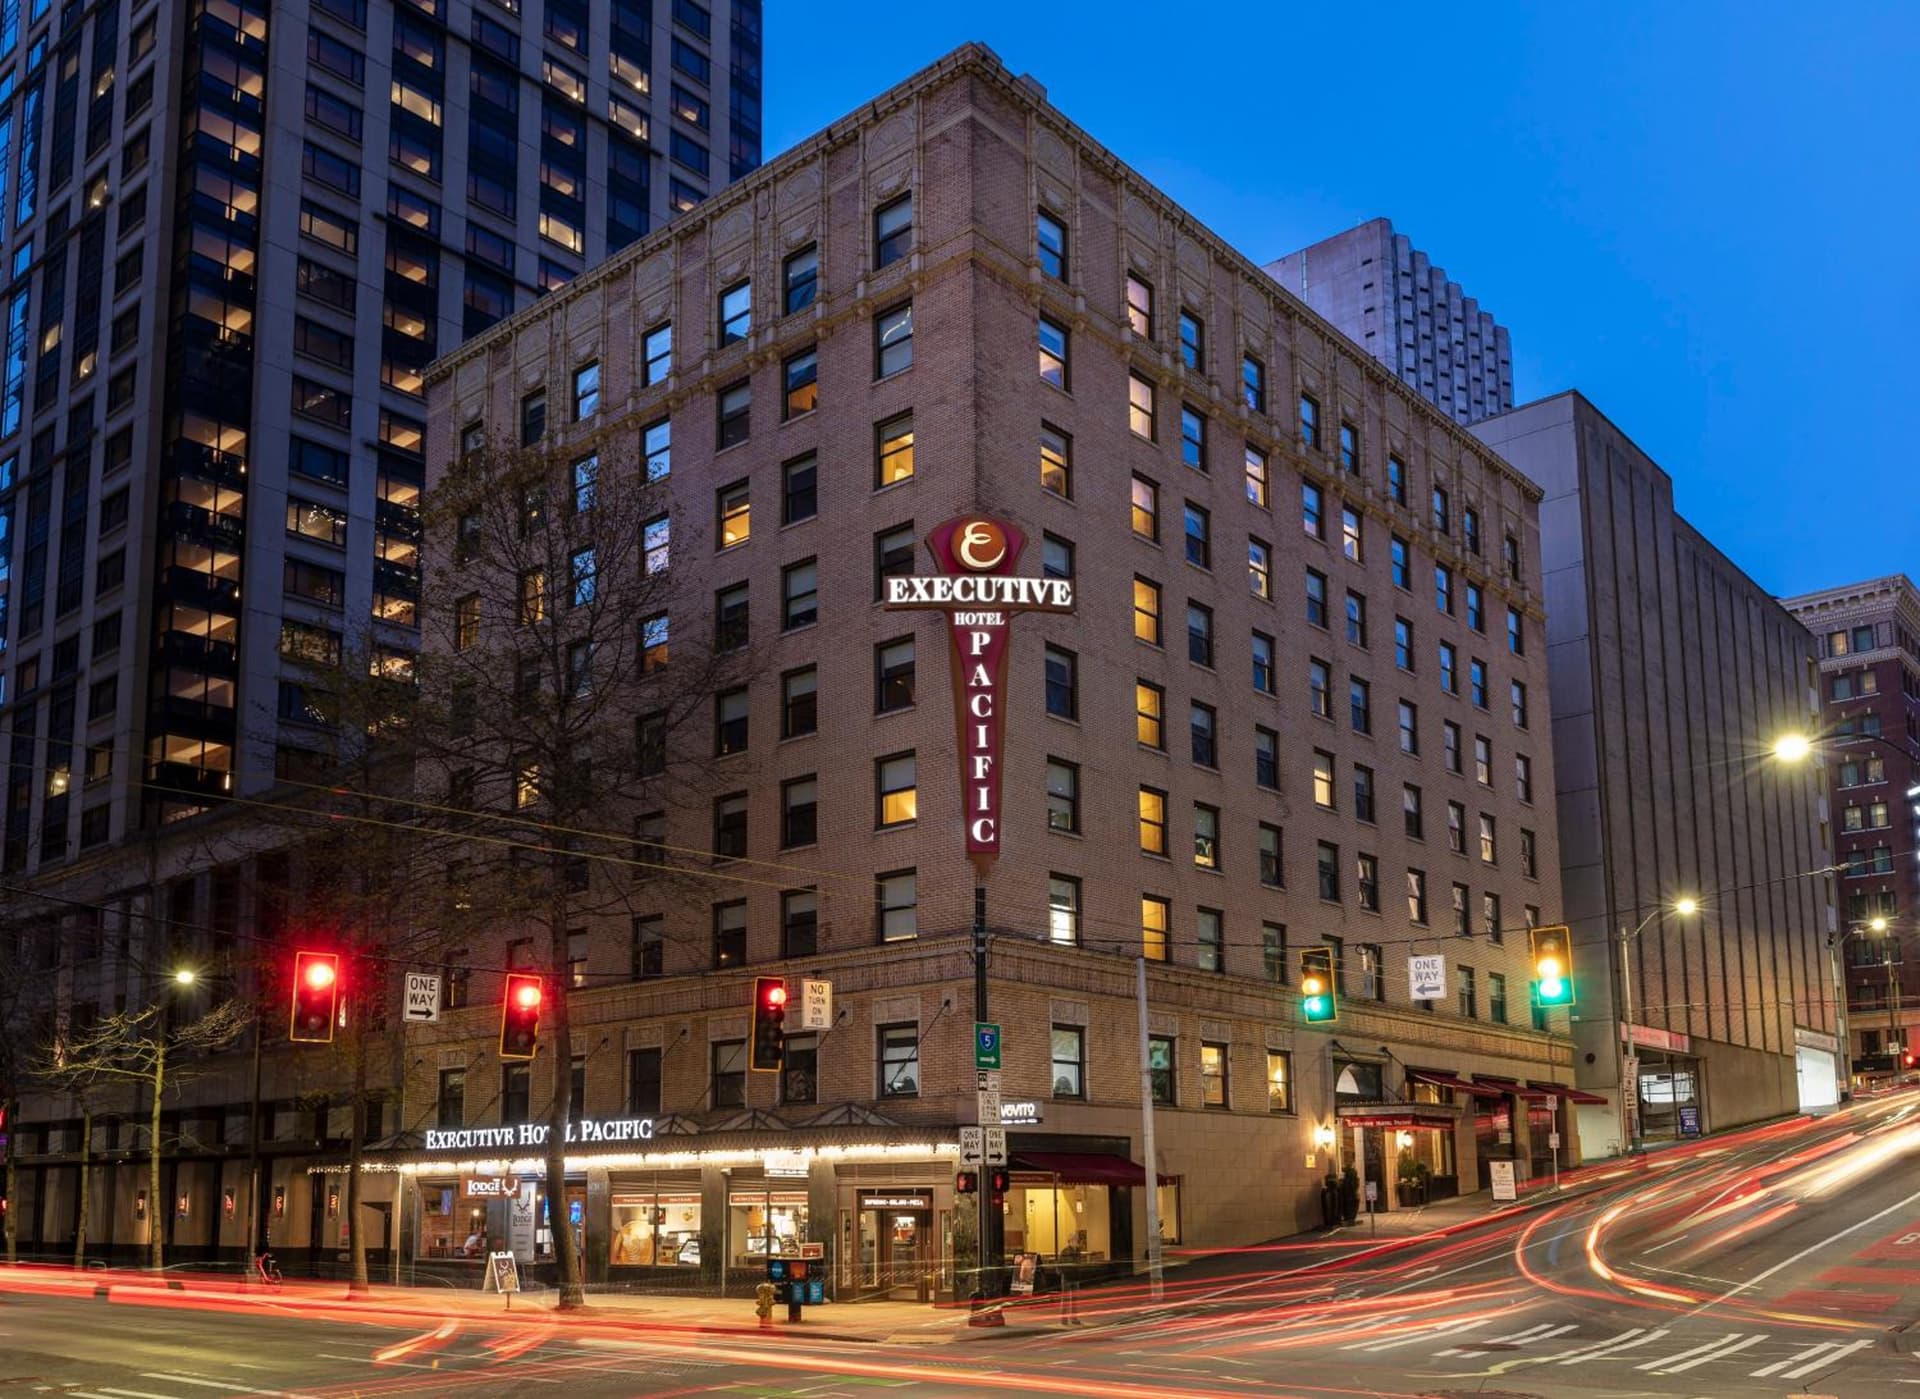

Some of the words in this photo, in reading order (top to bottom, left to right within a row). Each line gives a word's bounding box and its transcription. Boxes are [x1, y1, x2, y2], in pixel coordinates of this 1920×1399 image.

[887, 577, 1073, 606] EXECUTIVE
[954, 611, 1005, 625] HOTEL
[968, 630, 996, 844] PACIFIC
[1415, 959, 1439, 970] ONE
[1415, 970, 1439, 982] WAY
[410, 977, 436, 991] ONE
[810, 984, 824, 995] NO
[409, 992, 436, 1006] WAY
[812, 1006, 823, 1015] ON
[984, 1035, 992, 1048] 5
[581, 1119, 652, 1142] PACIFIC
[963, 1130, 979, 1140] ONE
[989, 1129, 1002, 1139] ONE
[467, 1179, 501, 1196] LODGE
